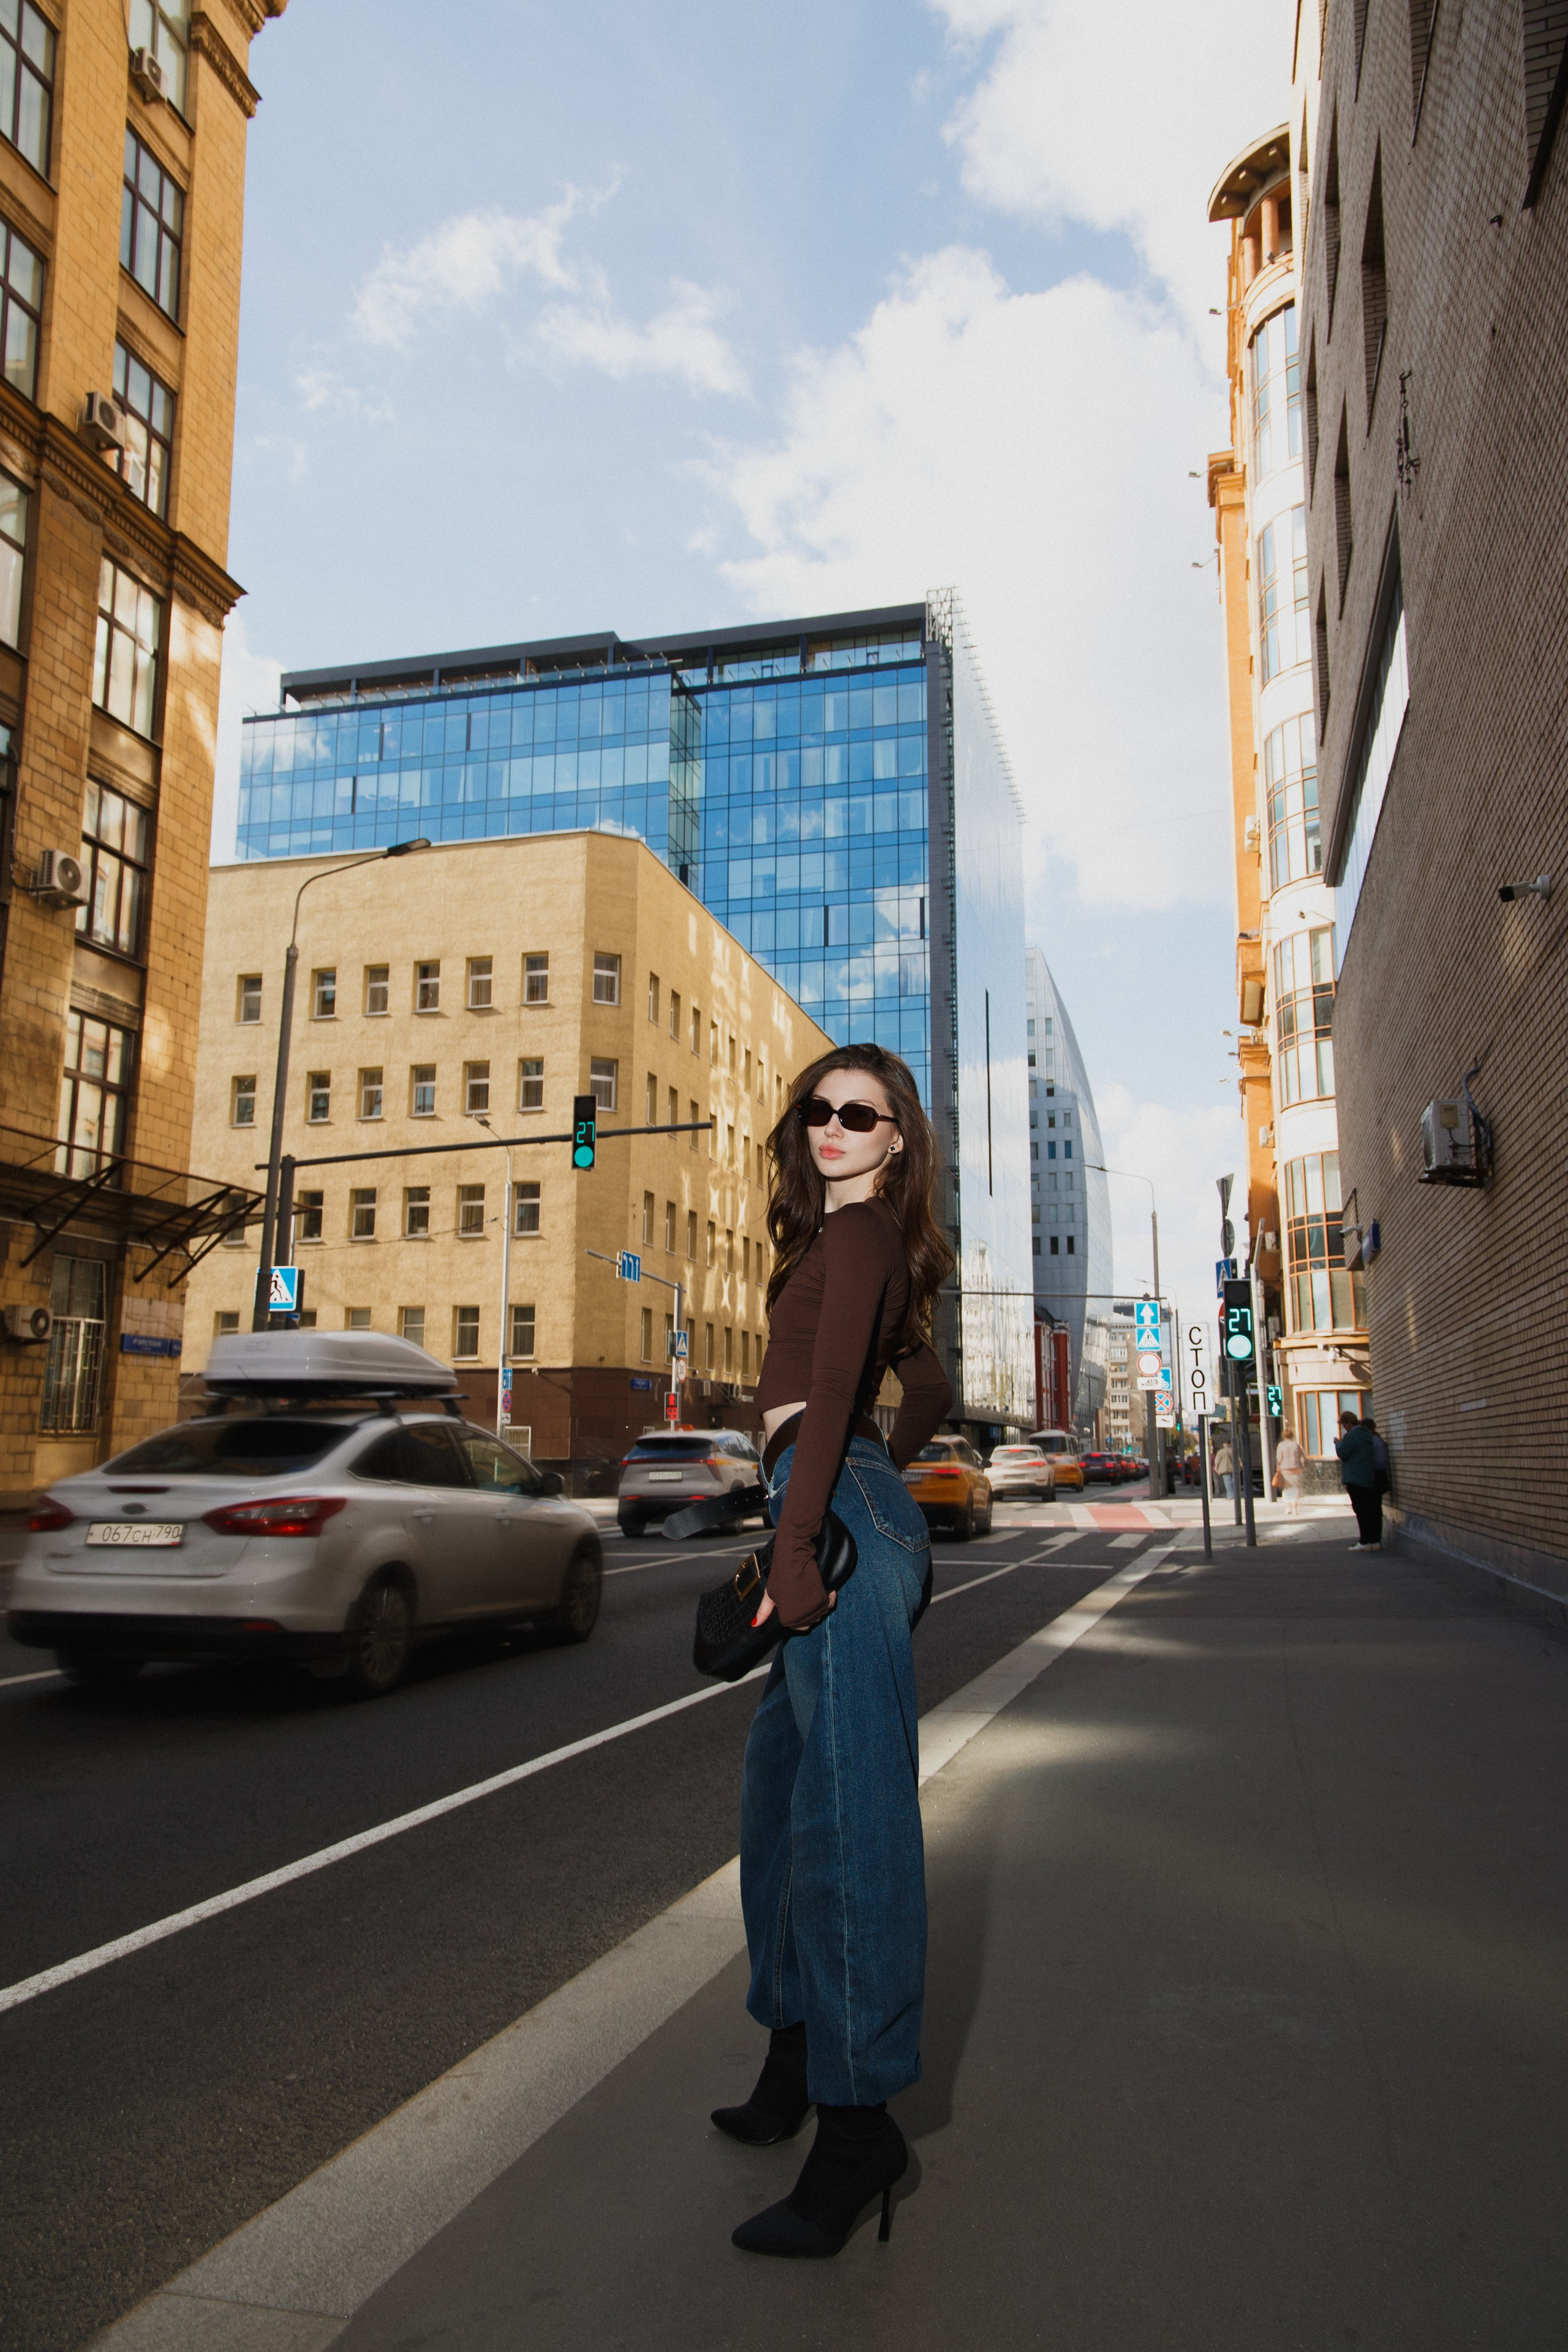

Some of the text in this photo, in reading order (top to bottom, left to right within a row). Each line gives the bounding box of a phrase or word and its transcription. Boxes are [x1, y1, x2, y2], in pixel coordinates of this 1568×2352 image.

[576, 1121, 595, 1144] 27
[1229, 1308, 1251, 1332] 27
[1189, 1326, 1206, 1411] СТОП
[1268, 1385, 1283, 1401] 27
